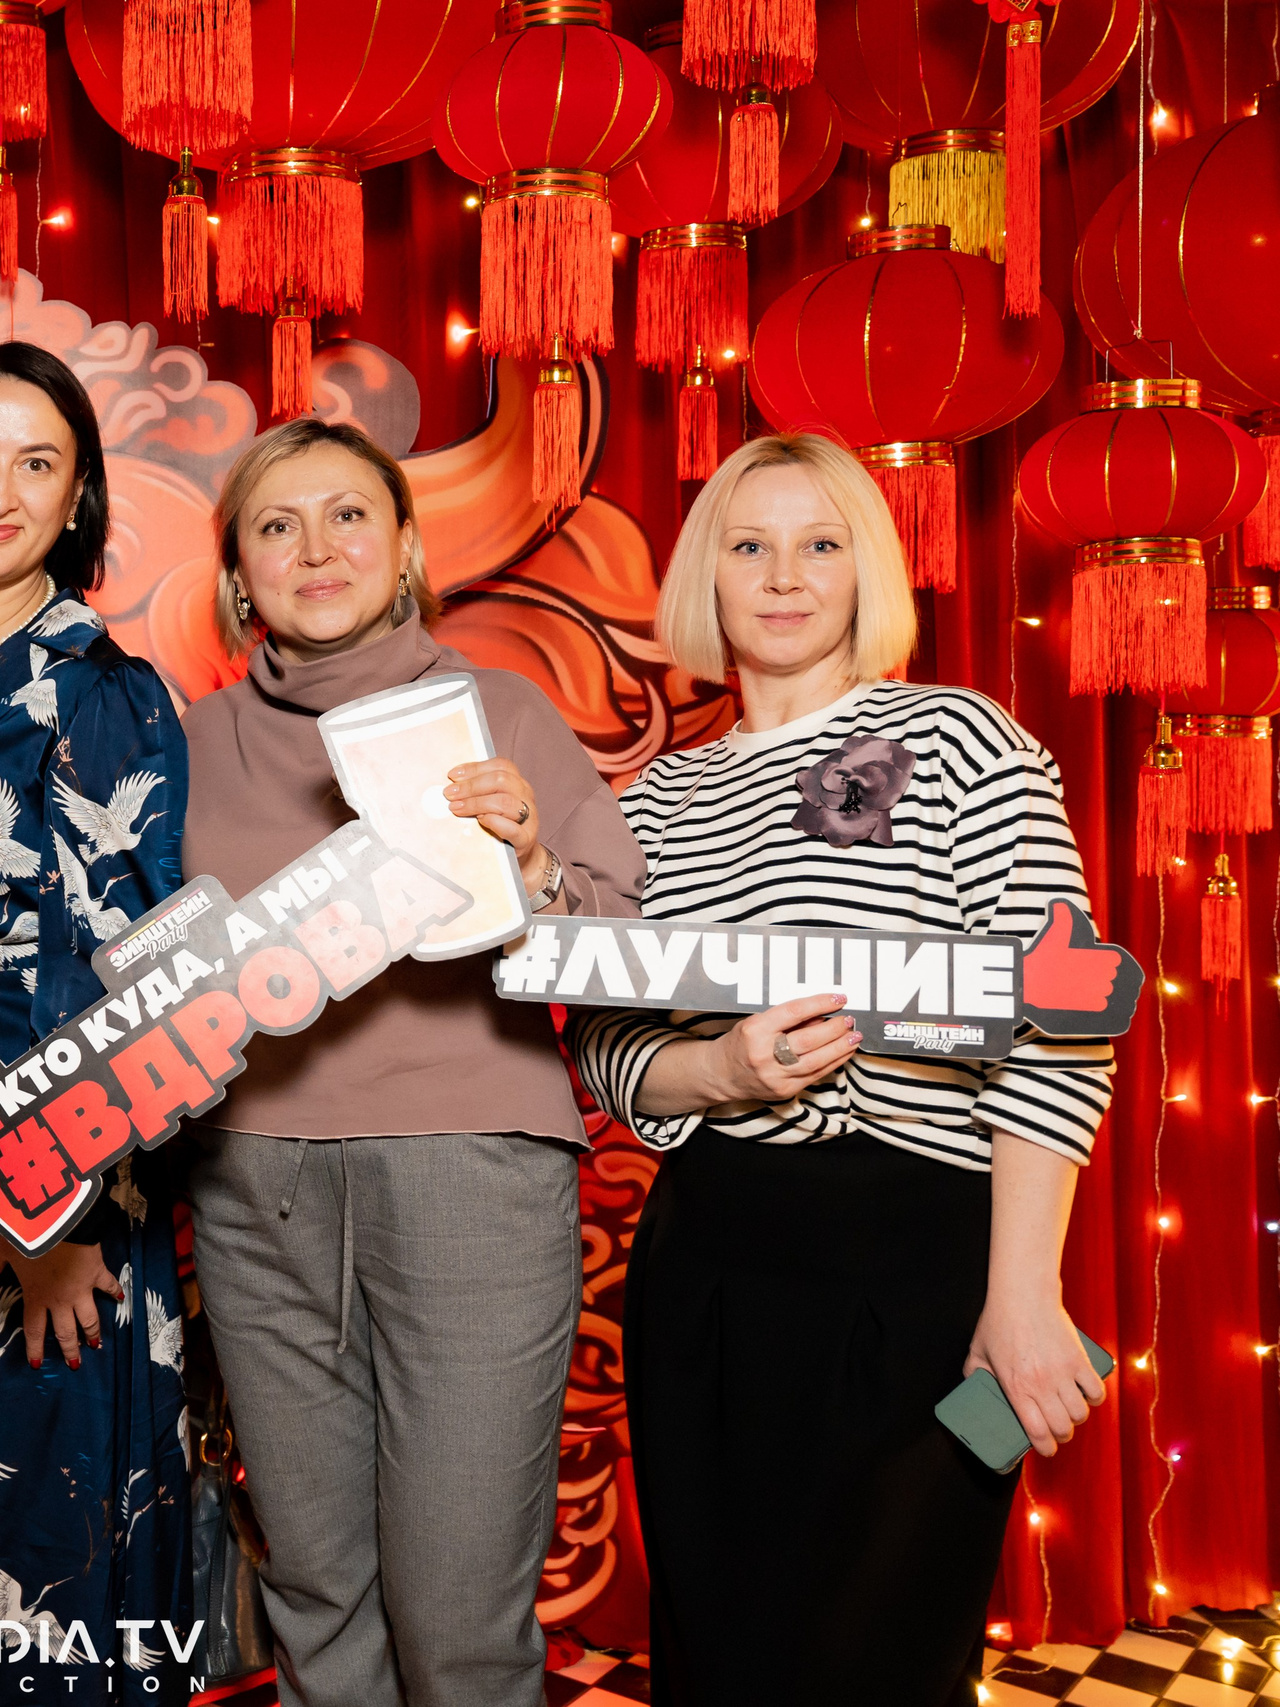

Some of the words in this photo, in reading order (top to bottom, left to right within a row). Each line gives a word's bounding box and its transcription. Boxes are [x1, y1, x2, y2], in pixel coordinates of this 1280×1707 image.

[110, 890, 211, 968] ЭЙНШТЕЙН
[146, 921, 188, 960] Party
[78, 948, 226, 1054] КУДА,
[225, 911, 268, 956] А
[498, 924, 1015, 1019] #ЛУЧШИЕ
[884, 1022, 984, 1042] ЭЙНШТЕЙН
[913, 1035, 955, 1053] Party
